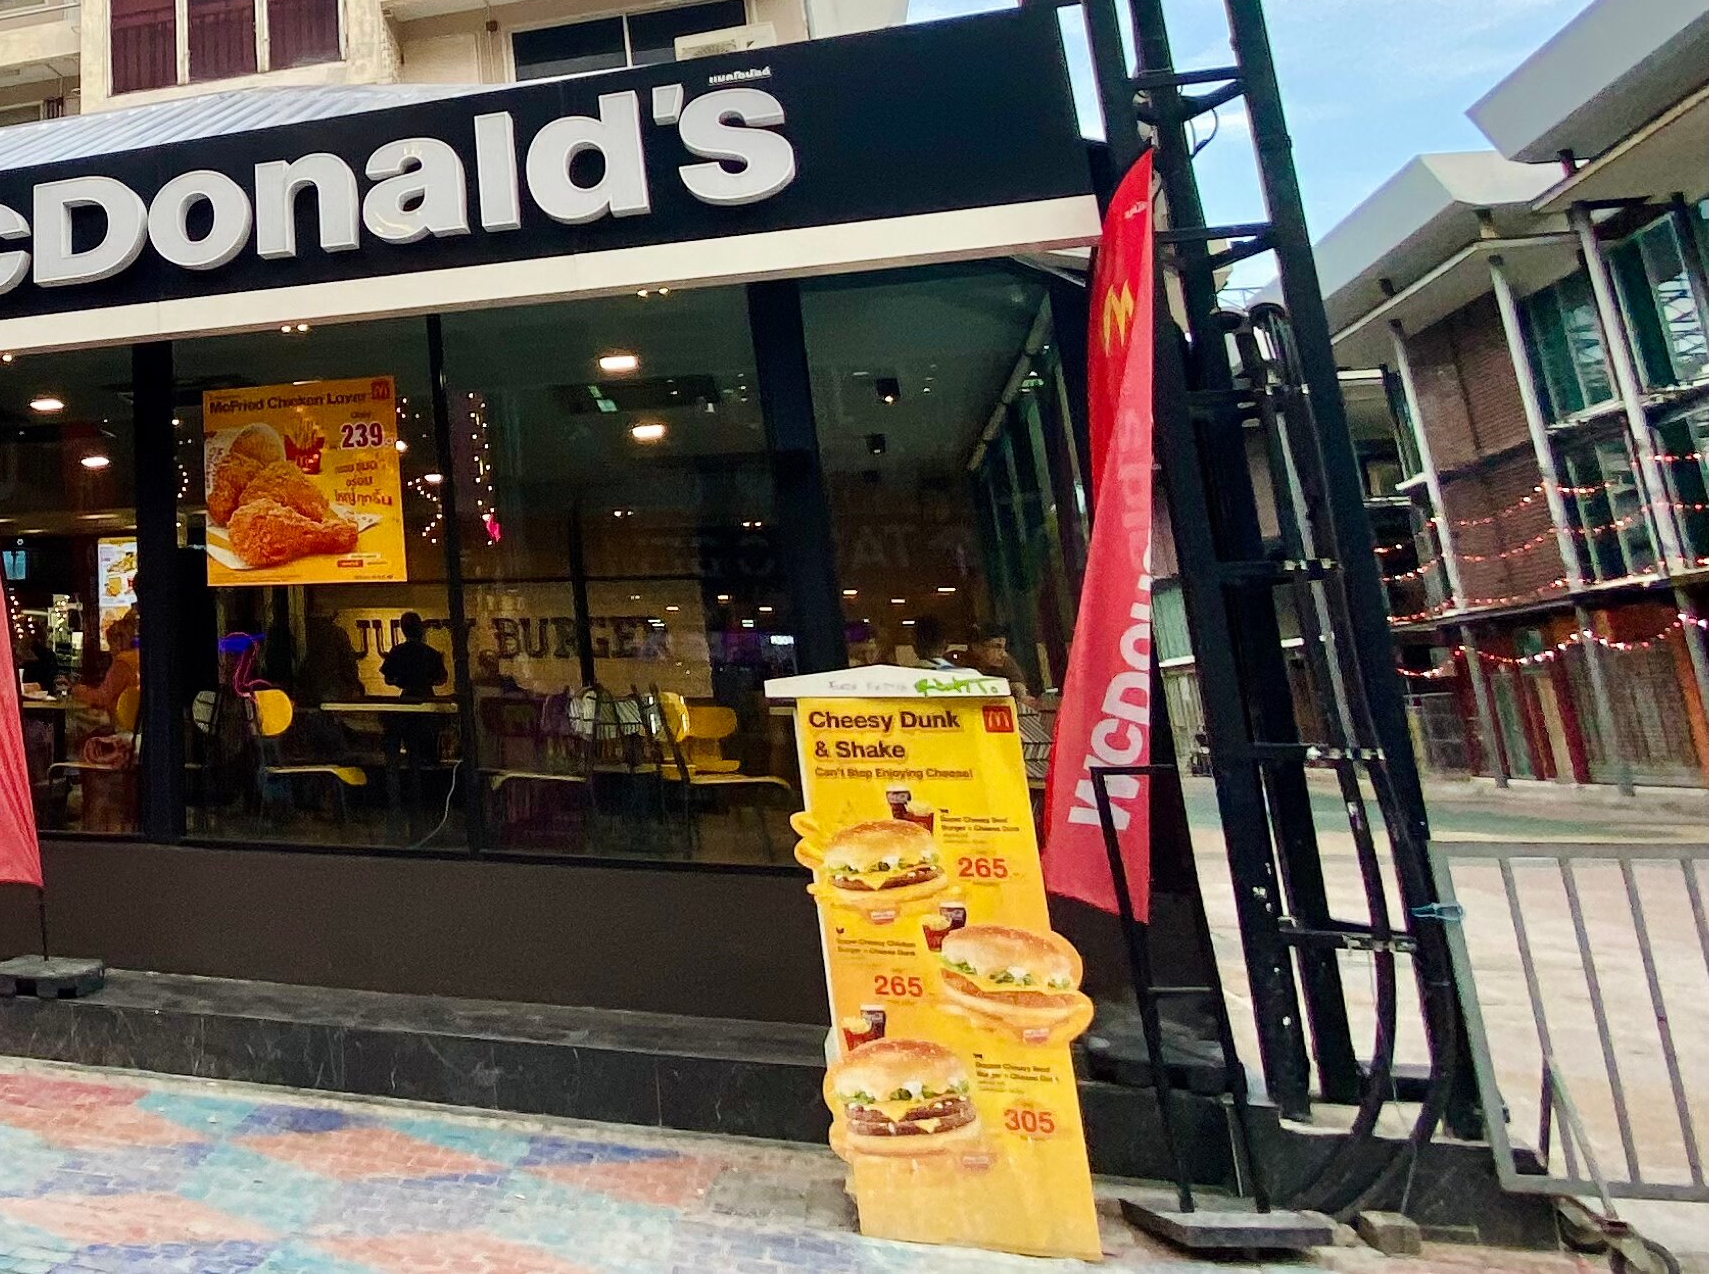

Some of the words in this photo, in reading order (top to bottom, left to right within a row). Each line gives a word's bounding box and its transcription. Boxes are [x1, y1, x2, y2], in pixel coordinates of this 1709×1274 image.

[340, 423, 383, 449] 239
[808, 710, 893, 733] Cheesy
[900, 710, 961, 729] Dunk
[814, 740, 829, 758] &
[835, 740, 906, 759] Shake
[875, 768, 924, 780] Enjoying
[958, 857, 1009, 879] 265
[874, 974, 923, 998] 265
[1004, 1109, 1055, 1134] 305
